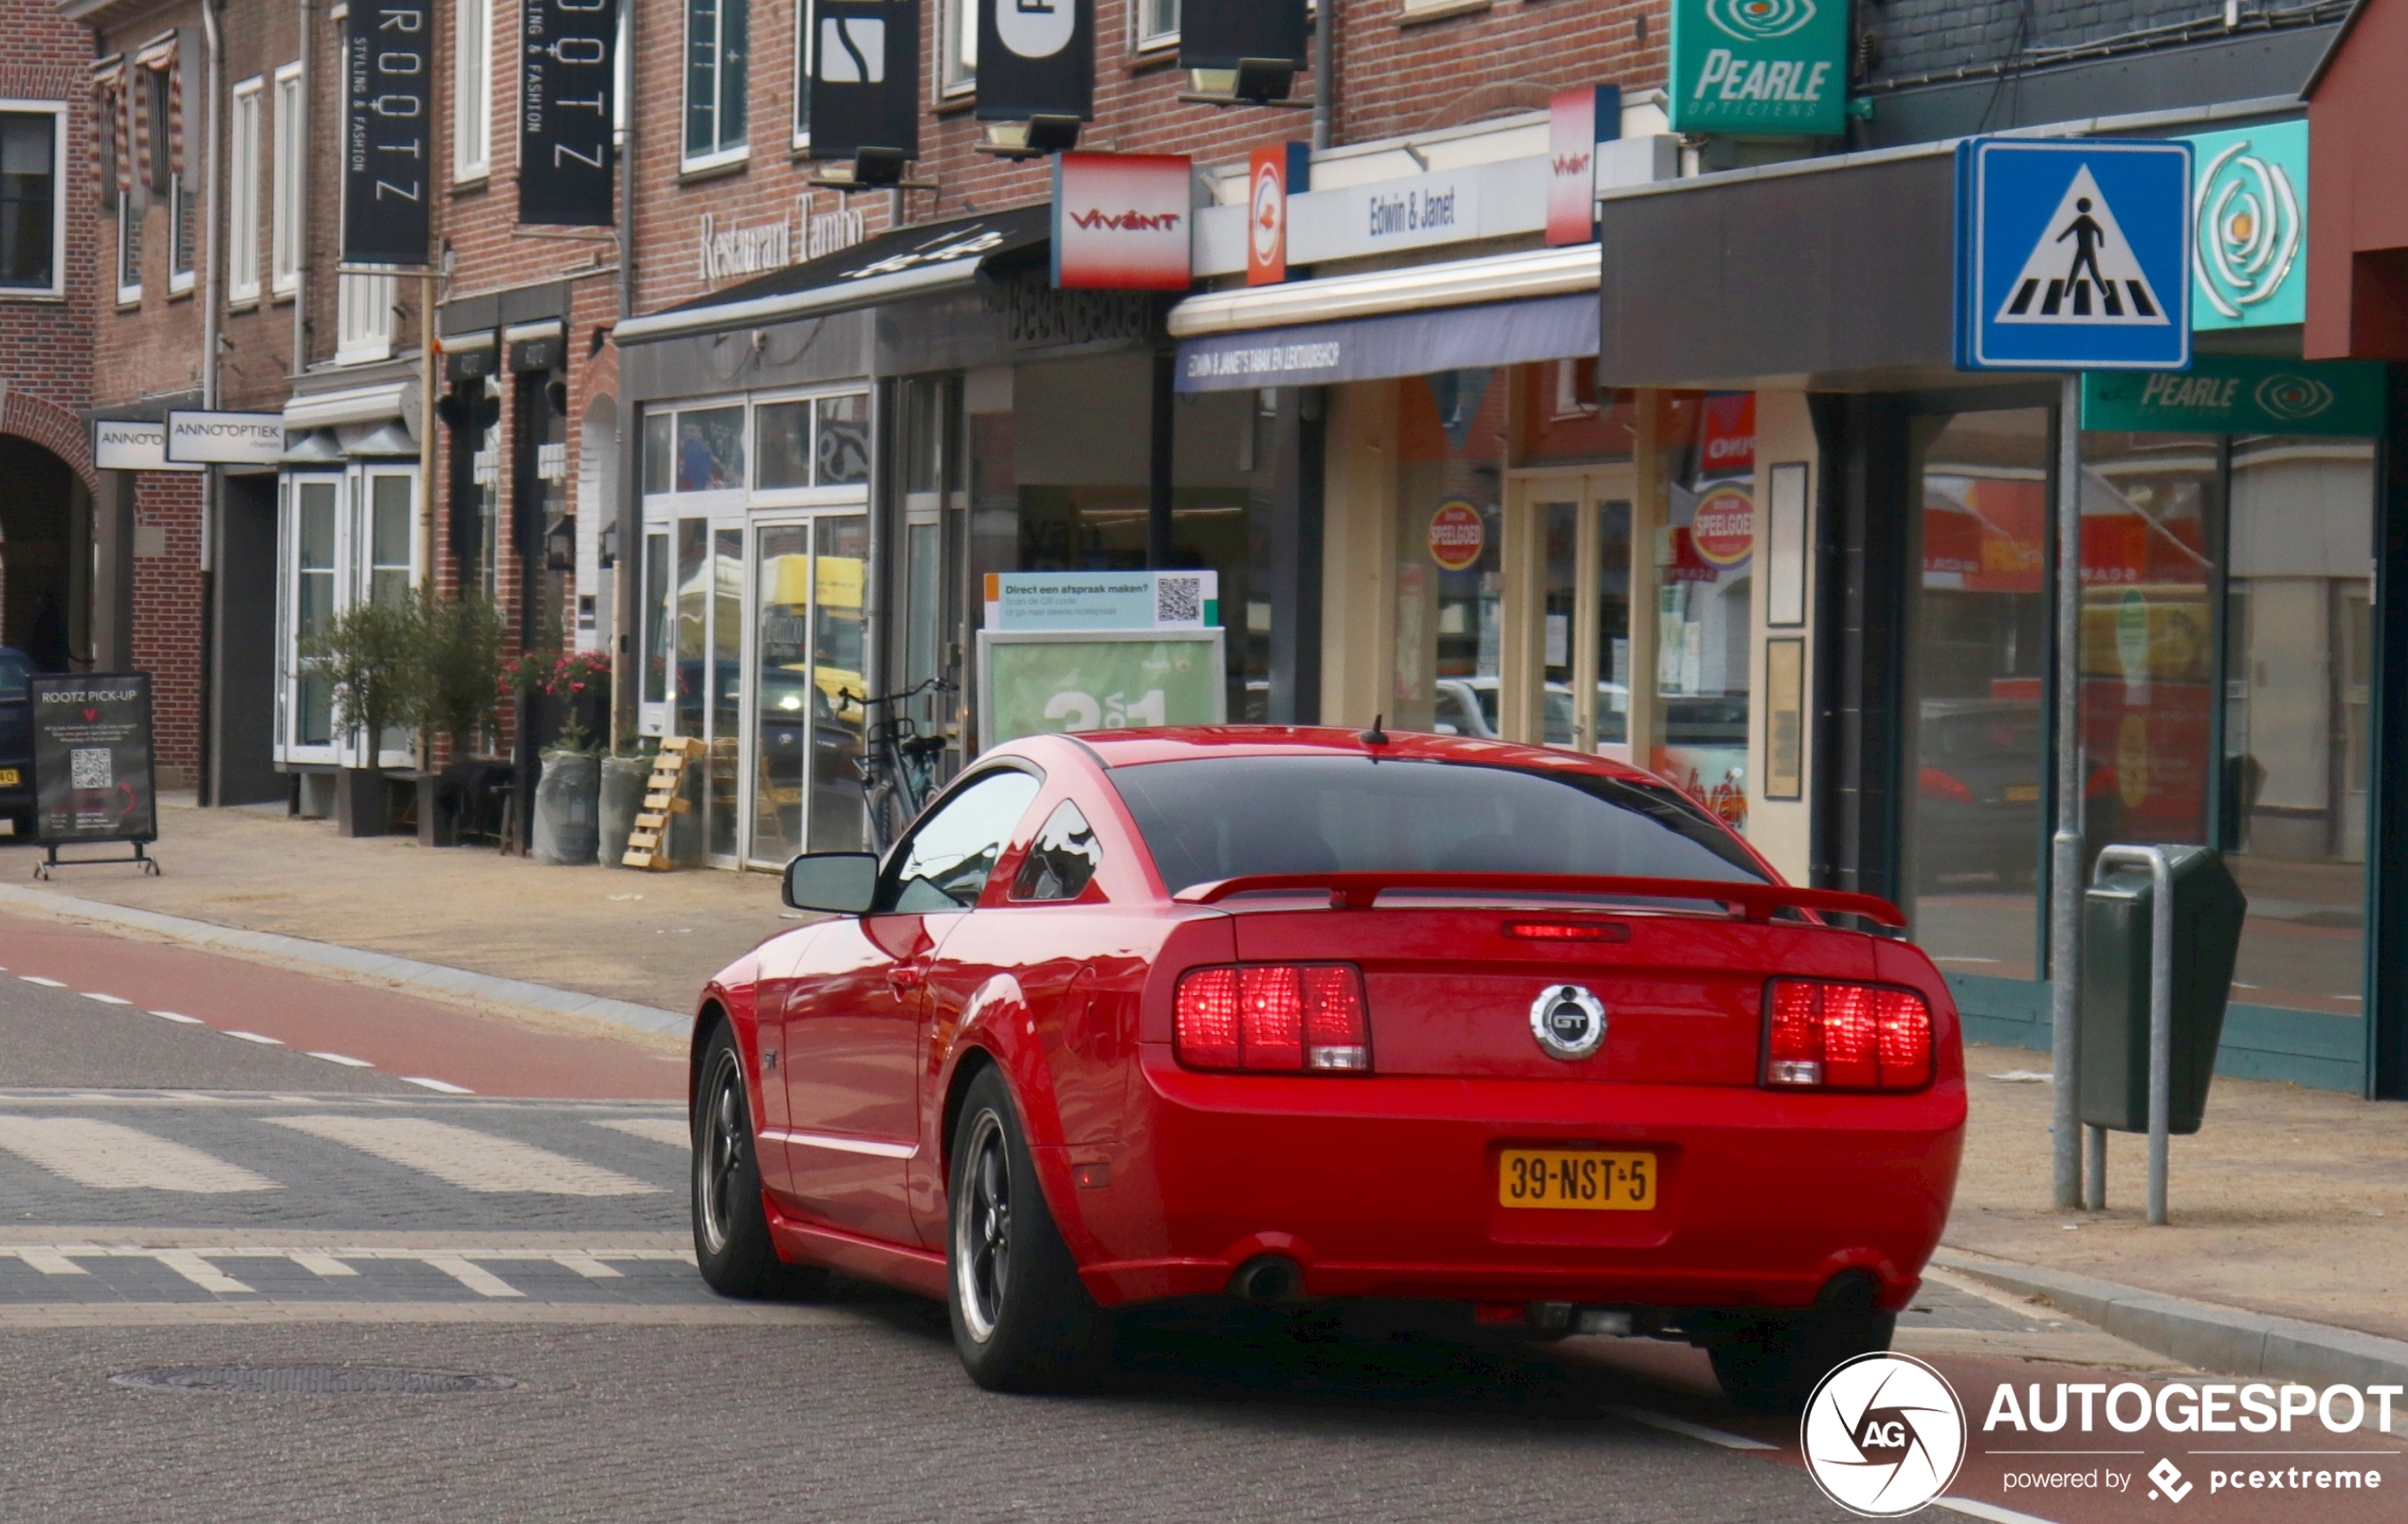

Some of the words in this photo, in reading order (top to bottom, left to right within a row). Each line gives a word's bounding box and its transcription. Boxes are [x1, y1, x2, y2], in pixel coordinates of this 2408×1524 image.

[353, 37, 367, 93] STYLING
[528, 44, 543, 53] &
[1693, 48, 1833, 100] PEARLE
[353, 100, 366, 108] &
[376, 9, 422, 201] ROOTZ
[527, 64, 543, 133] FASHION
[1688, 101, 1818, 117] OPTICIENS
[352, 115, 366, 172] FASHION
[1370, 192, 1406, 237] Edwin
[1409, 190, 1418, 230] &
[1421, 186, 1455, 229] Janet
[700, 208, 792, 281] Restaurant
[795, 189, 865, 263] Tambo
[2141, 372, 2241, 408] PEARLE
[1431, 524, 1481, 545] SPEELGOED
[1005, 585, 1037, 594] Direct
[1040, 586, 1059, 594] een
[1062, 584, 1105, 596] afspraak
[1108, 584, 1149, 594] maken?
[42, 691, 86, 703] ROOTZ
[87, 690, 137, 702] PICK-UP
[1554, 1015, 1587, 1029] GT
[1510, 1157, 1646, 1202] 39-NST-5
